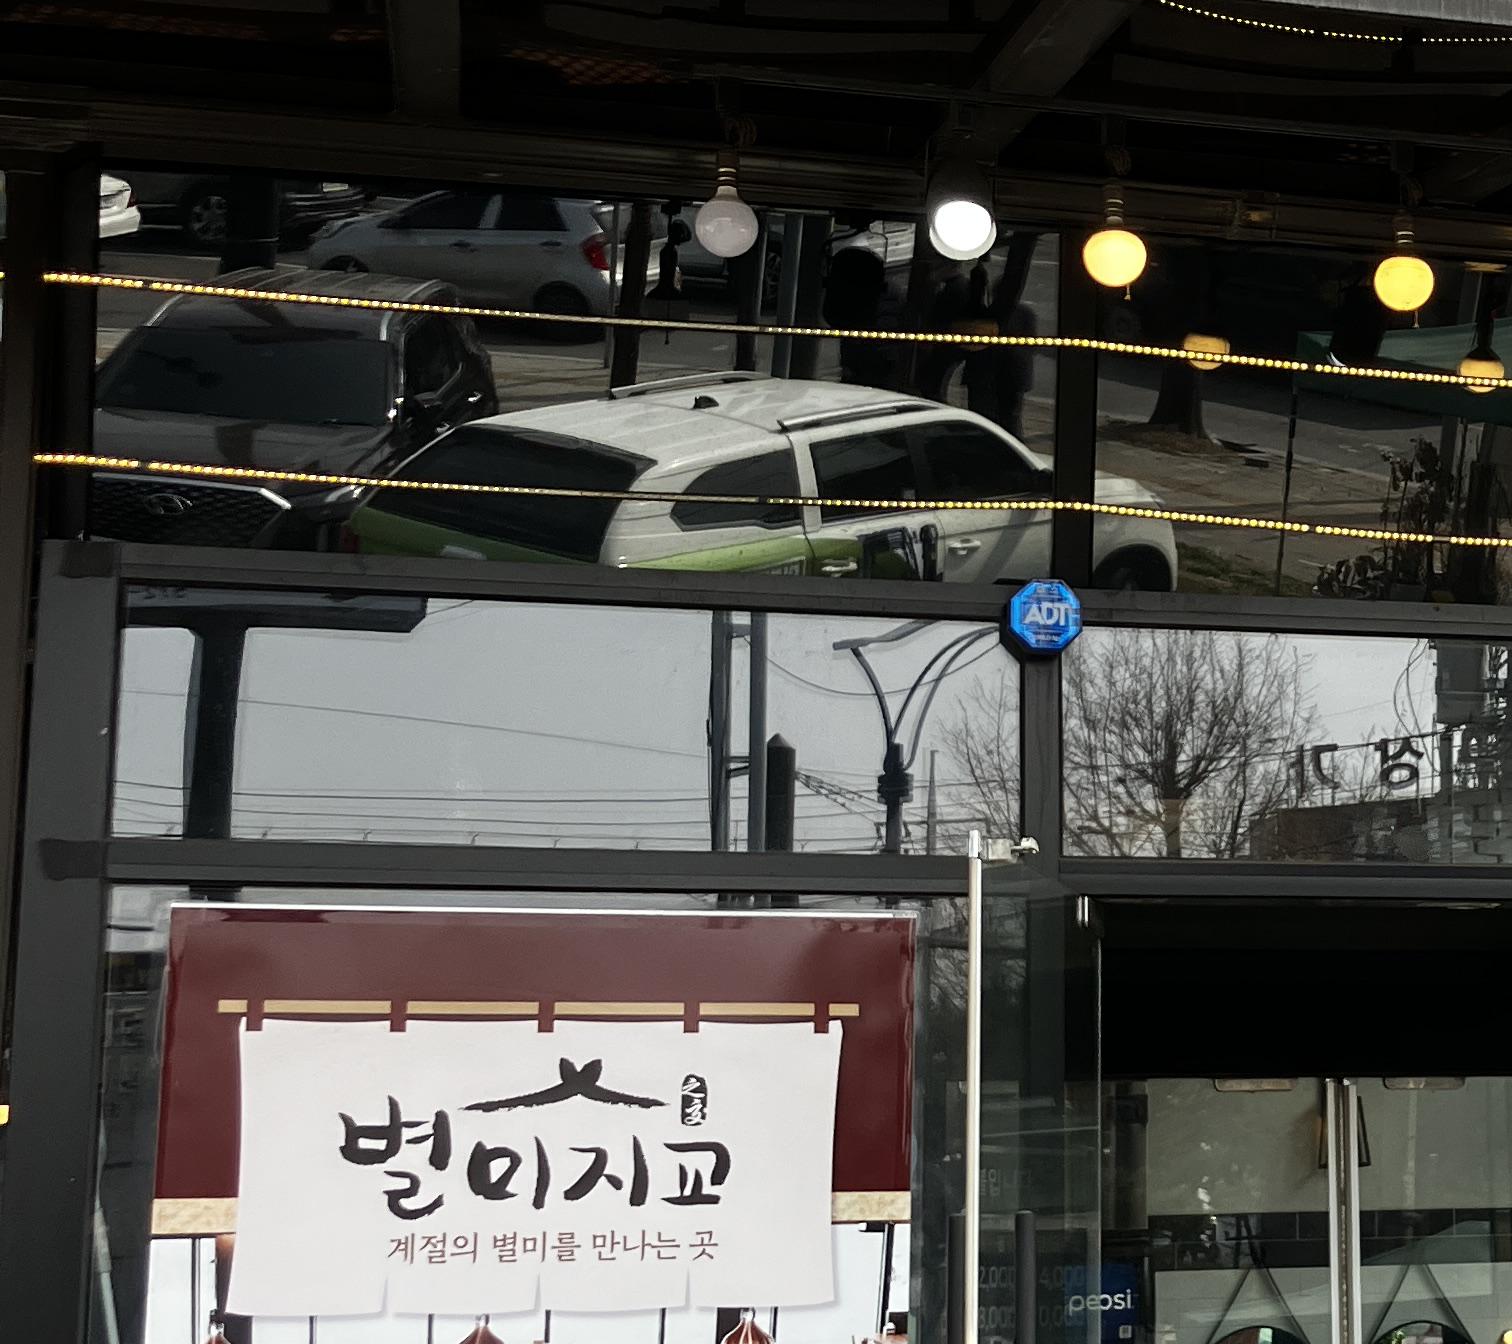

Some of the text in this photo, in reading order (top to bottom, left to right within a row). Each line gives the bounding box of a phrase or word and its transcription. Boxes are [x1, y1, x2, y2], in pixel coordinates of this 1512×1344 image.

[1022, 601, 1072, 627] ADT
[338, 1095, 731, 1219] 별미지교
[387, 1229, 719, 1265] 계절의 별미를 만나는 곳
